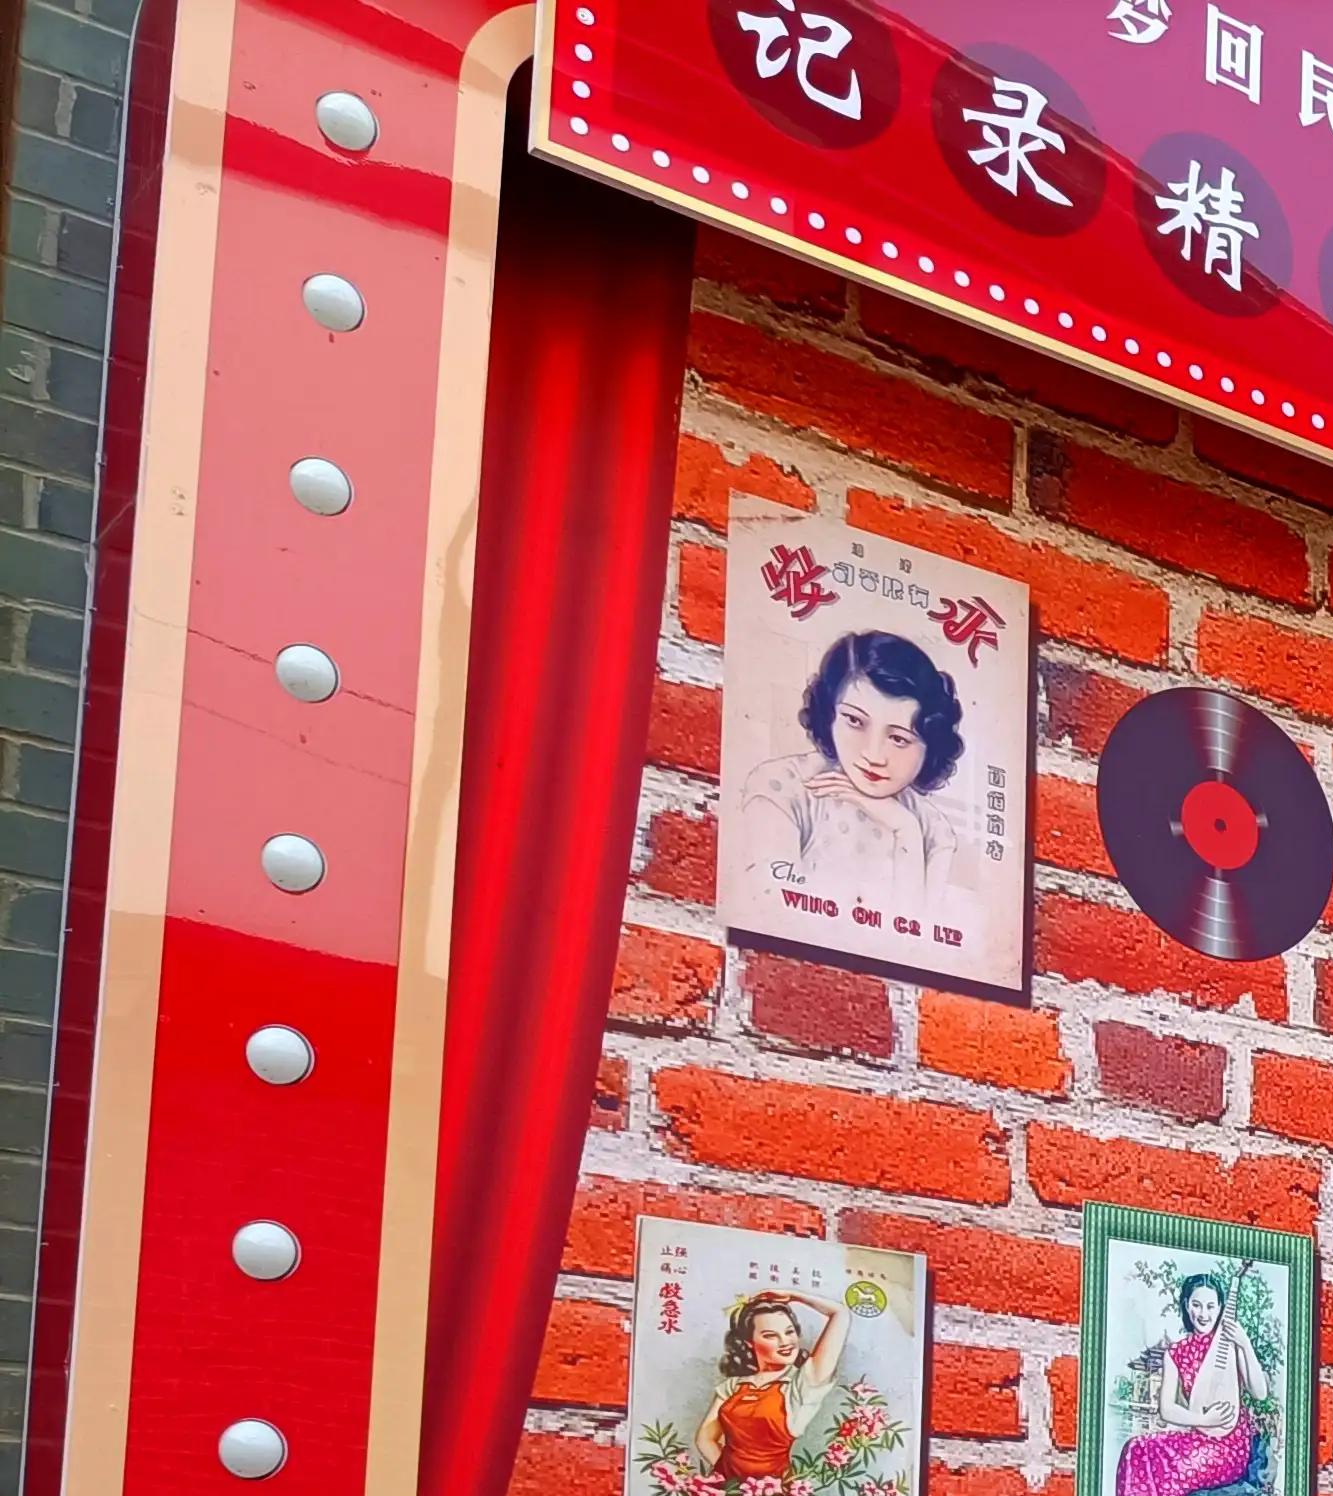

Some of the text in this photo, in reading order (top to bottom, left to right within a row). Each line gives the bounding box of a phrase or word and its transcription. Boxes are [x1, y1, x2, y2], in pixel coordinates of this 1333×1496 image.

[770, 860, 806, 885] The
[781, 888, 839, 917] WING
[852, 906, 882, 929] ON
